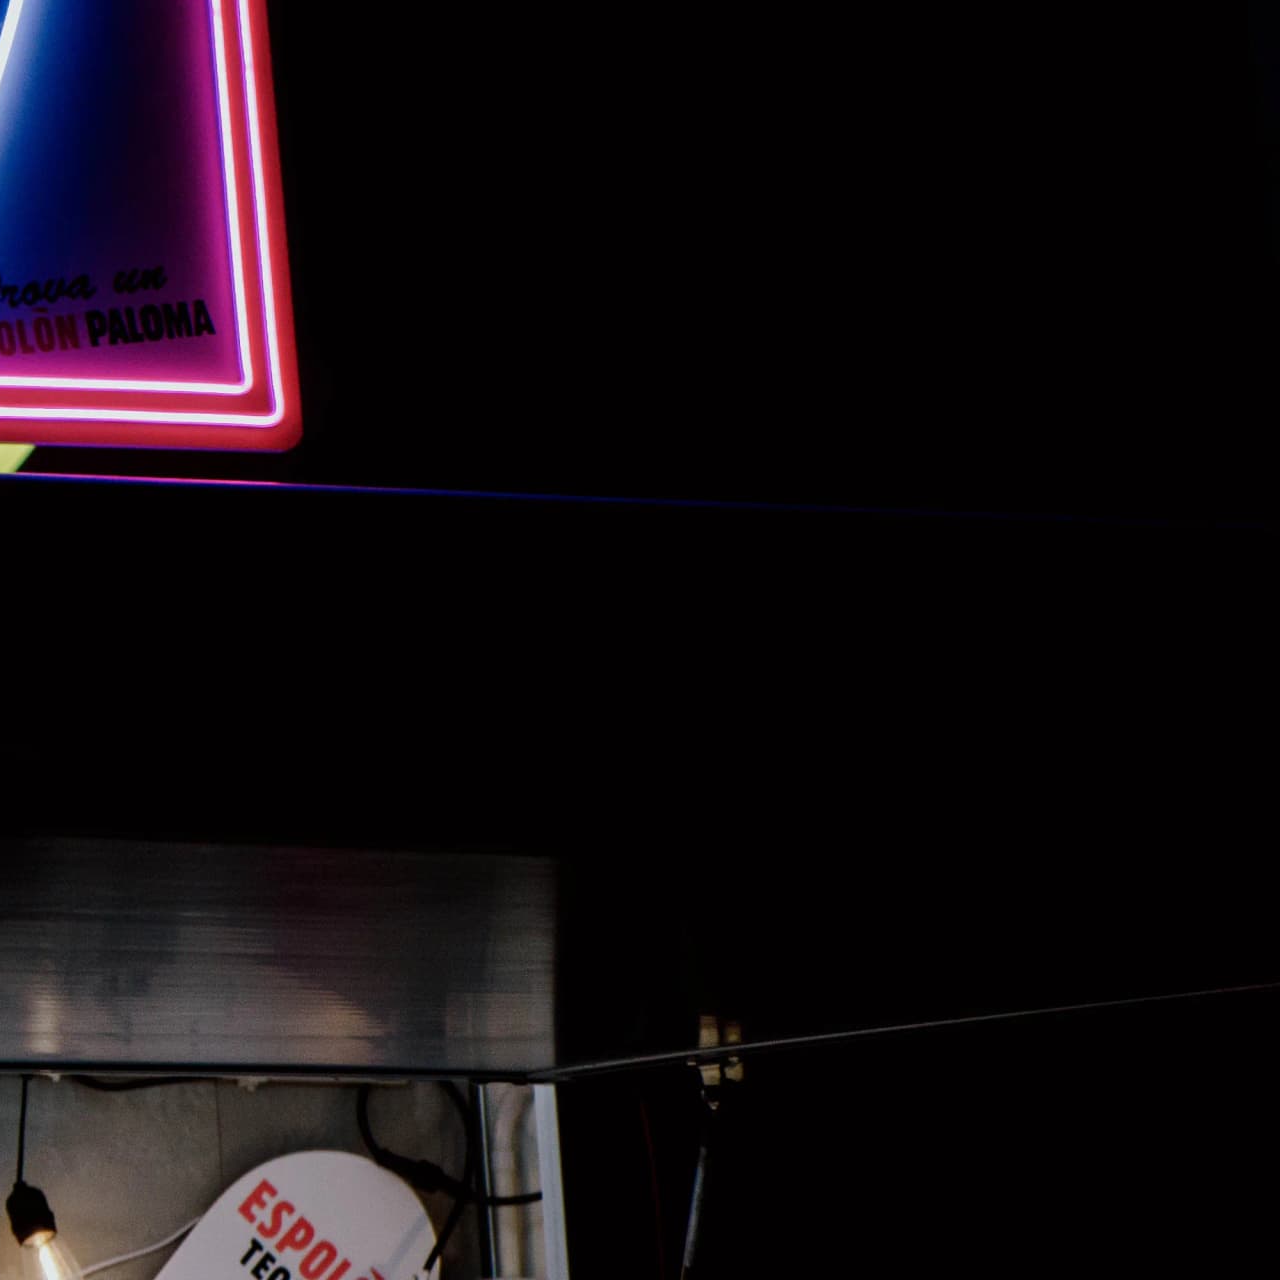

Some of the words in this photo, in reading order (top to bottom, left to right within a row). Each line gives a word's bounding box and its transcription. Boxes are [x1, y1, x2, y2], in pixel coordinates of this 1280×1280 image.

[113, 266, 169, 294] un
[85, 299, 216, 347] PALOMA
[238, 1178, 385, 1280] ESPOL
